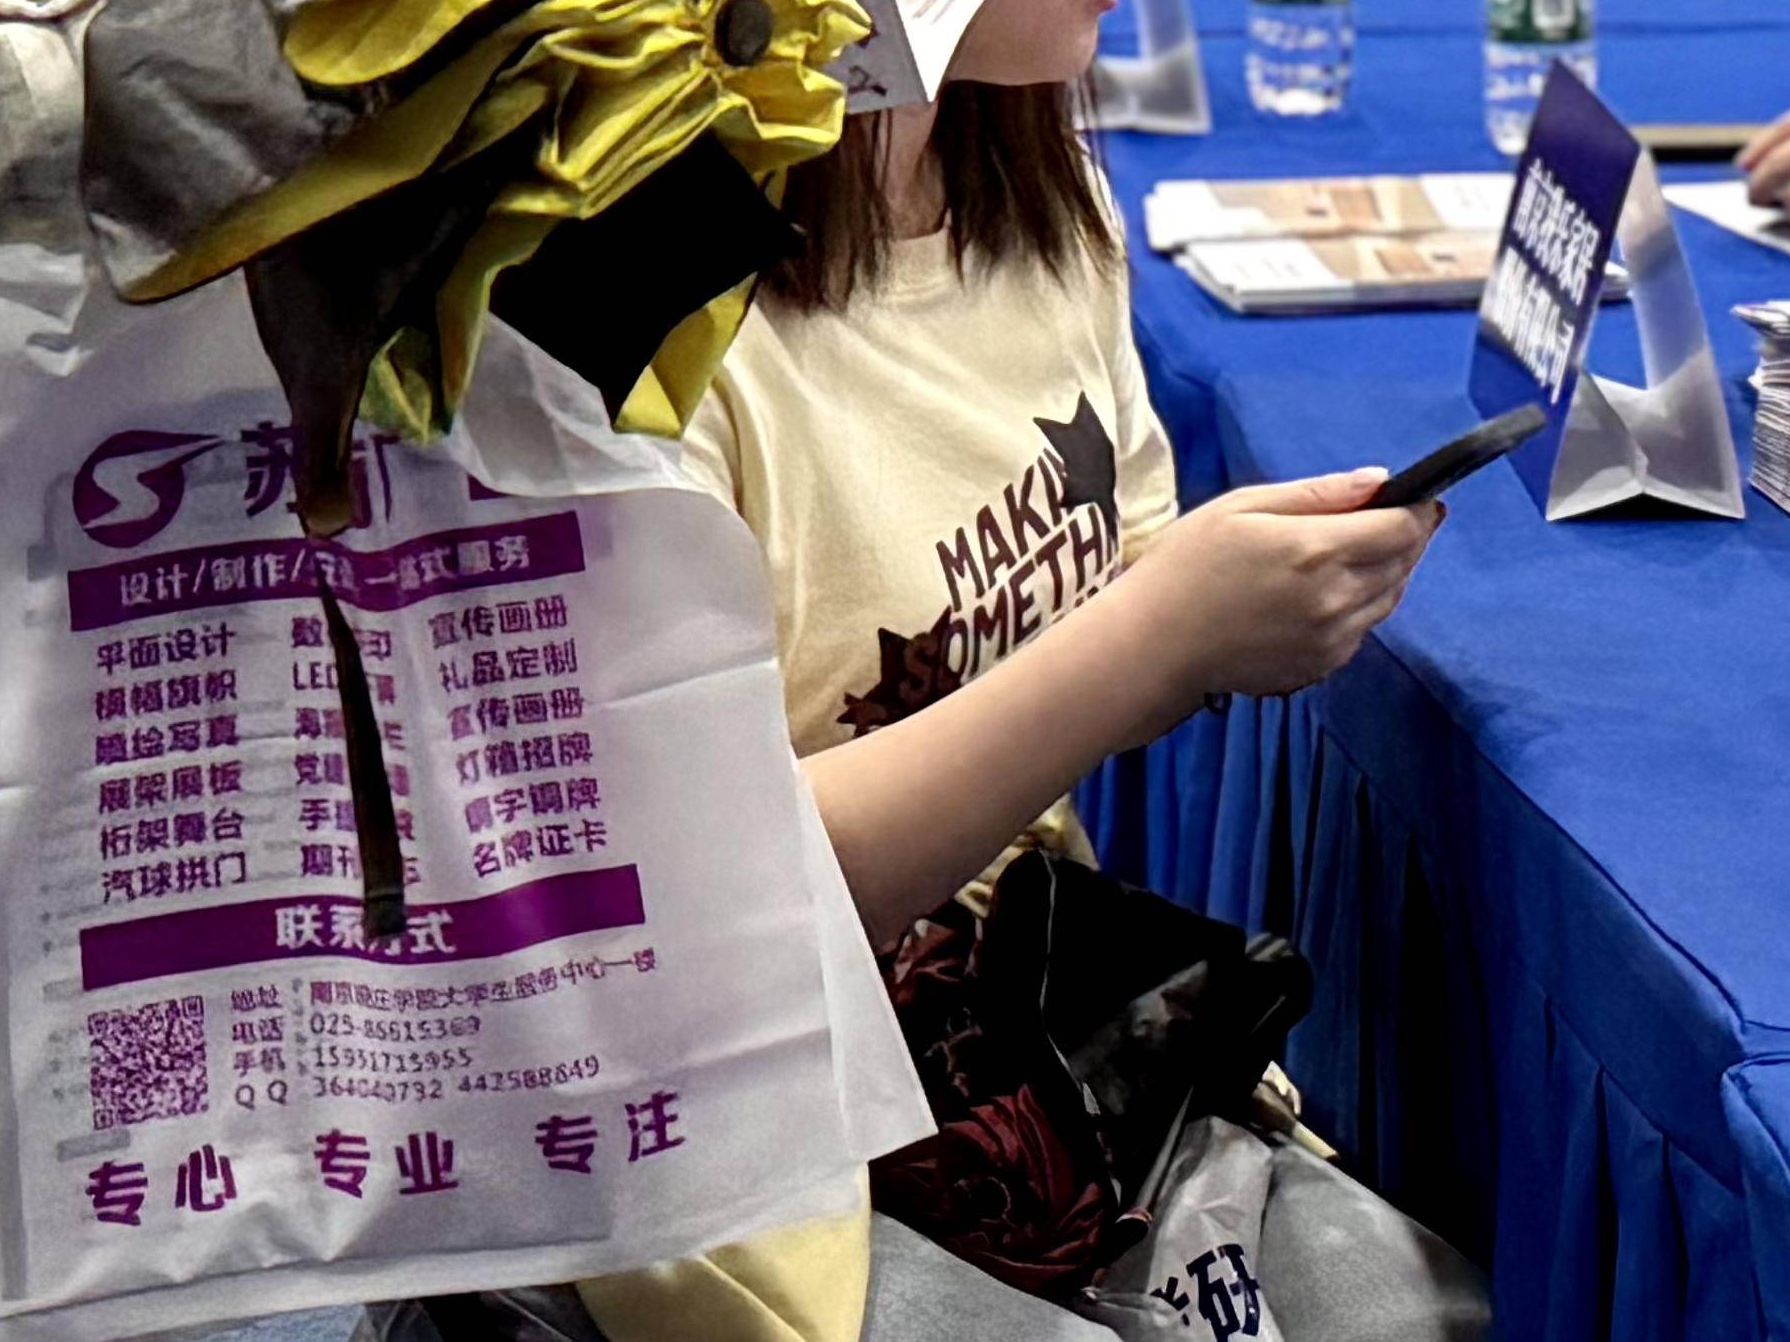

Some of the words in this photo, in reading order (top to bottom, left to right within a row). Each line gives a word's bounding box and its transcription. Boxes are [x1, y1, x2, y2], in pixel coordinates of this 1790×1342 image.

[96, 623, 236, 672] 平面设计
[428, 595, 568, 648] 宣传画册
[439, 640, 578, 692] 礼品定制
